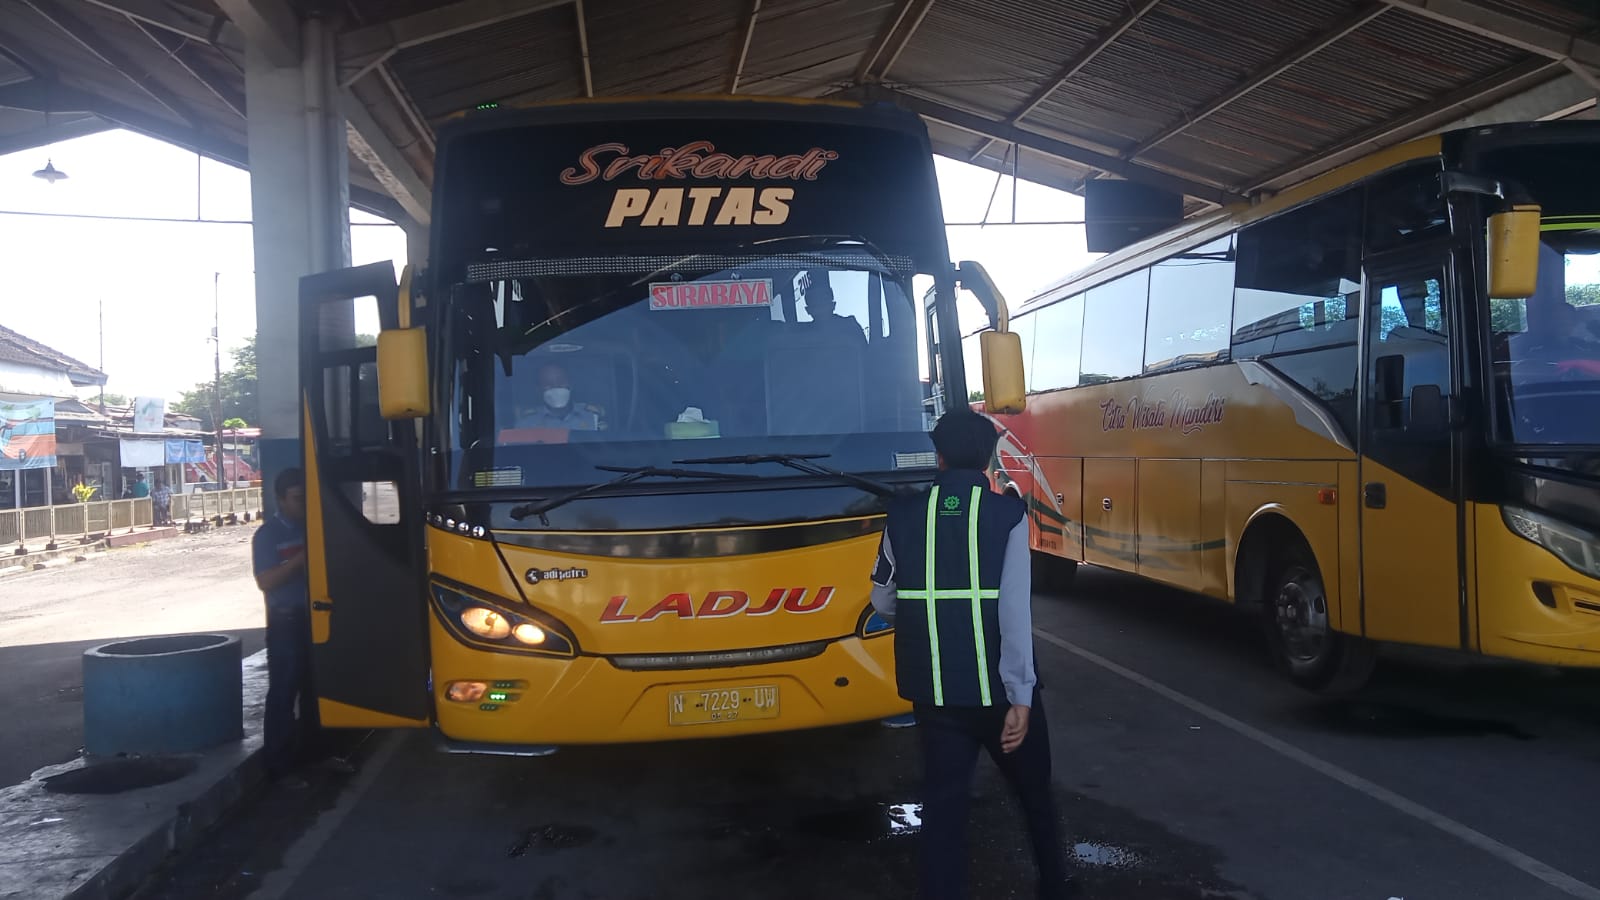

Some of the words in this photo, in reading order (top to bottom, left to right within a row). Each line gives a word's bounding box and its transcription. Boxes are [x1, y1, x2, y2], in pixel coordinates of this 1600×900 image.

[559, 140, 838, 185] Srikandi
[604, 186, 795, 227] PATAS
[652, 281, 770, 308] SURABAYA
[600, 586, 836, 624] LADJU
[673, 694, 684, 713] N
[700, 690, 740, 712] 7229
[754, 687, 776, 708] UW
